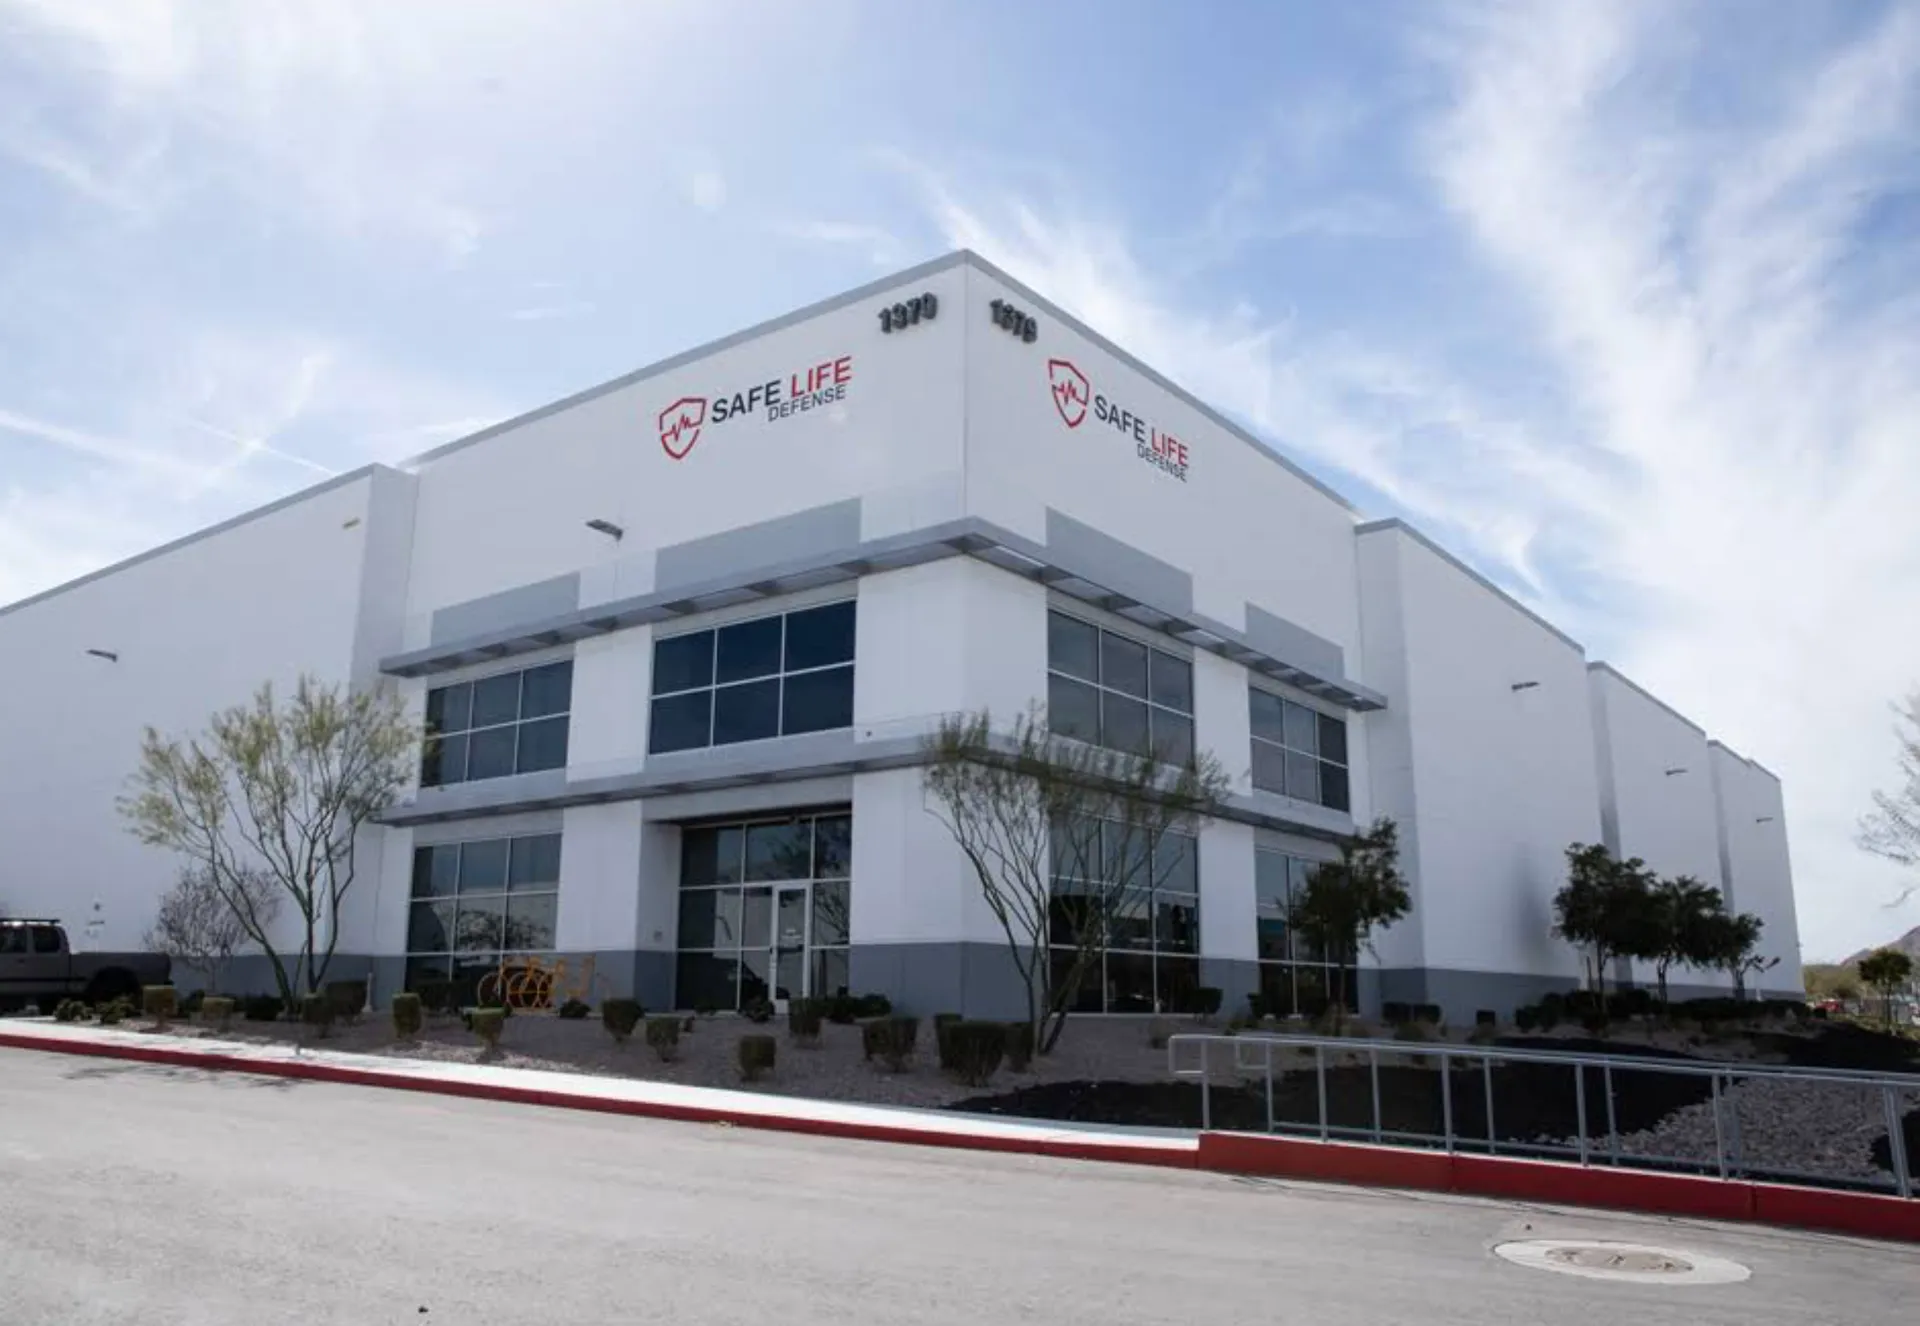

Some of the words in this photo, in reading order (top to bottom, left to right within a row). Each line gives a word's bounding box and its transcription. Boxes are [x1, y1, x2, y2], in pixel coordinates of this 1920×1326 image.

[711, 379, 782, 424] SAFE
[791, 356, 853, 398] LIFE
[767, 384, 847, 423] DEFENSE
[1094, 394, 1147, 444] SAFE
[1151, 427, 1189, 468] LIFE
[1136, 443, 1189, 484] DEFENSE
